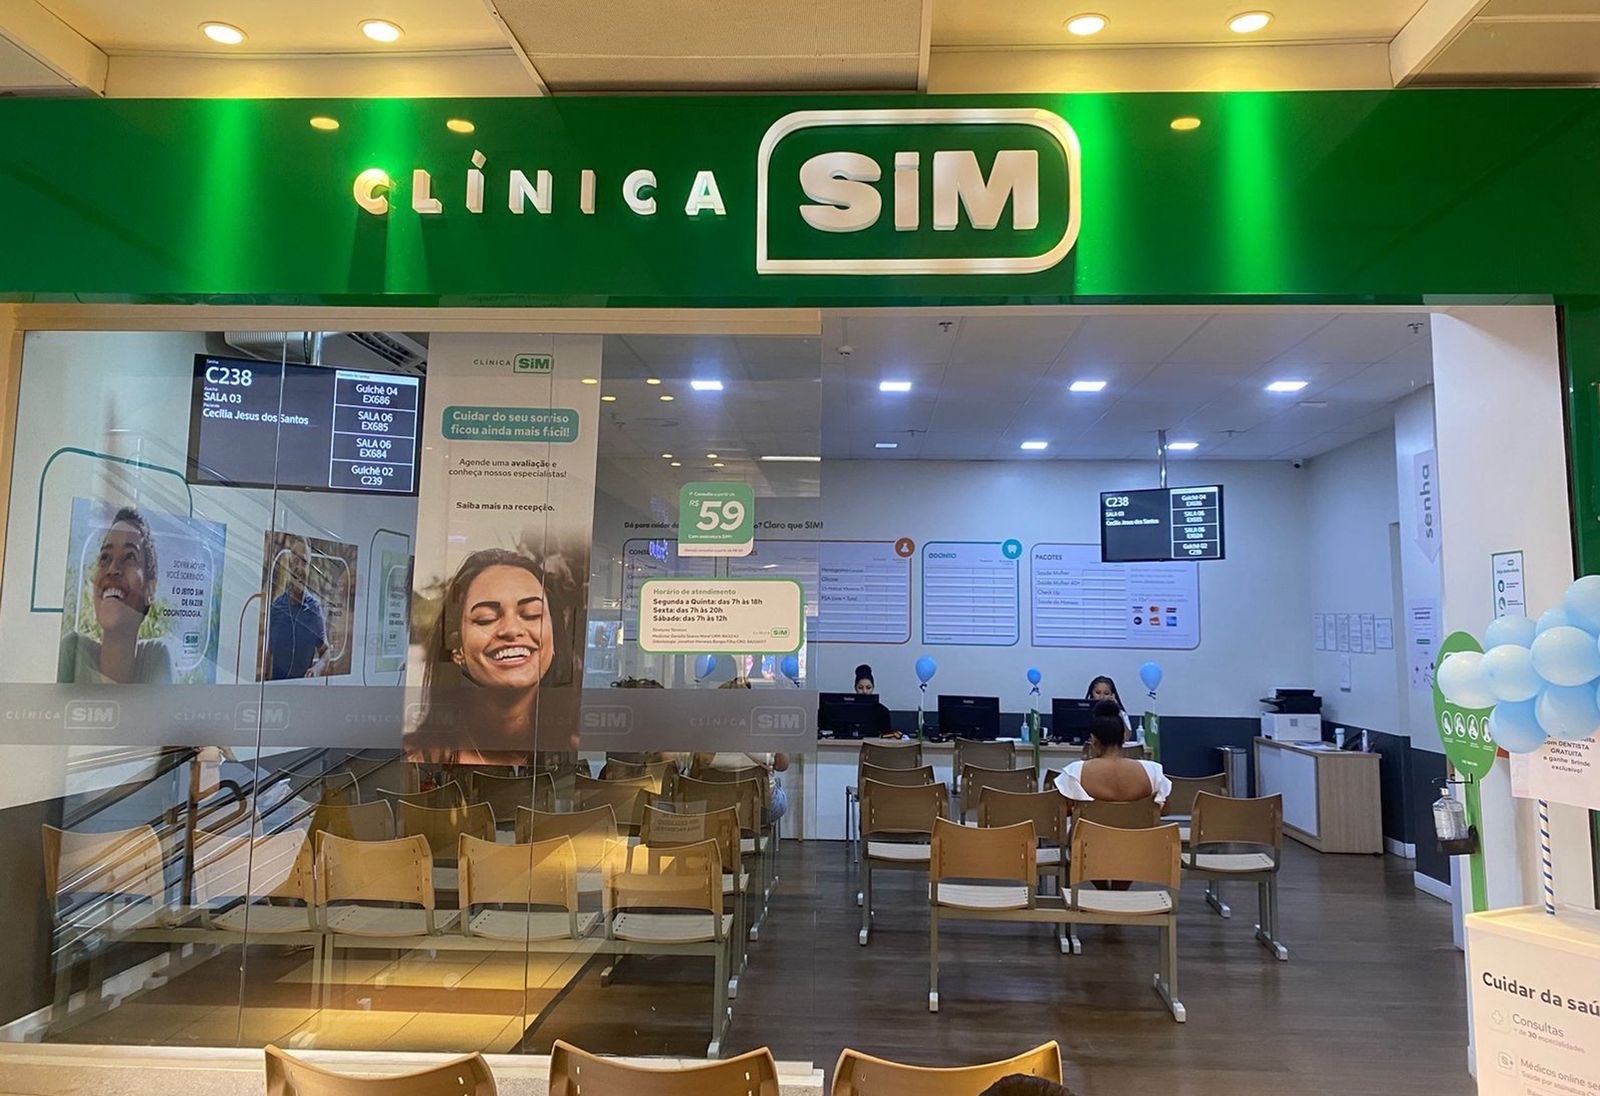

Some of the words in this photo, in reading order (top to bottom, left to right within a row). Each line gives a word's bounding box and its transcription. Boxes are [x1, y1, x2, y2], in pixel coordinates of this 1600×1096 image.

[352, 149, 728, 216] CLÍNICA
[206, 366, 252, 386] C238
[386, 386, 398, 396] 04
[204, 392, 228, 403] SALA
[230, 394, 242, 404] 03
[362, 394, 391, 405] EX686
[234, 410, 260, 421] Jesus
[261, 412, 278, 422] dos
[280, 414, 309, 425] Santos
[358, 410, 380, 421] SALA
[381, 413, 393, 422] 06
[452, 410, 490, 422] Cuidar
[492, 412, 506, 422] do
[508, 414, 528, 423] seu
[530, 413, 570, 424] sorriso
[361, 422, 388, 432] EX685
[450, 424, 479, 434] ficou
[481, 425, 512, 436] ainda
[514, 427, 540, 437] mais
[542, 427, 570, 438] fácil!
[356, 438, 378, 448] SALA
[380, 440, 392, 450] 06
[360, 448, 387, 459] EX684
[459, 458, 490, 468] Agende
[511, 459, 550, 468] avaliação
[382, 467, 394, 477] 02
[448, 468, 482, 478] conheça
[514, 470, 568, 478] especialistas!
[360, 476, 383, 486] C239
[456, 502, 480, 510] Saiba
[482, 502, 501, 510] mais
[514, 503, 555, 512] recepção.
[1106, 496, 1129, 508] C238
[1419, 464, 1434, 539] senha
[688, 499, 700, 508] R$
[696, 500, 745, 532] 59
[763, 521, 786, 529] Claro
[653, 598, 685, 606] Segunda
[242, 708, 284, 723] SM
[1558, 741, 1590, 750] DENTISTA
[1550, 748, 1583, 757] GRATUITA
[1551, 765, 1583, 774] exclusivo!
[1482, 972, 1536, 1000] Cuidar
[1540, 989, 1562, 1007] da
[1512, 1013, 1564, 1038] Consultas
[1528, 1030, 1537, 1040] 30
[1558, 1071, 1586, 1087] online
